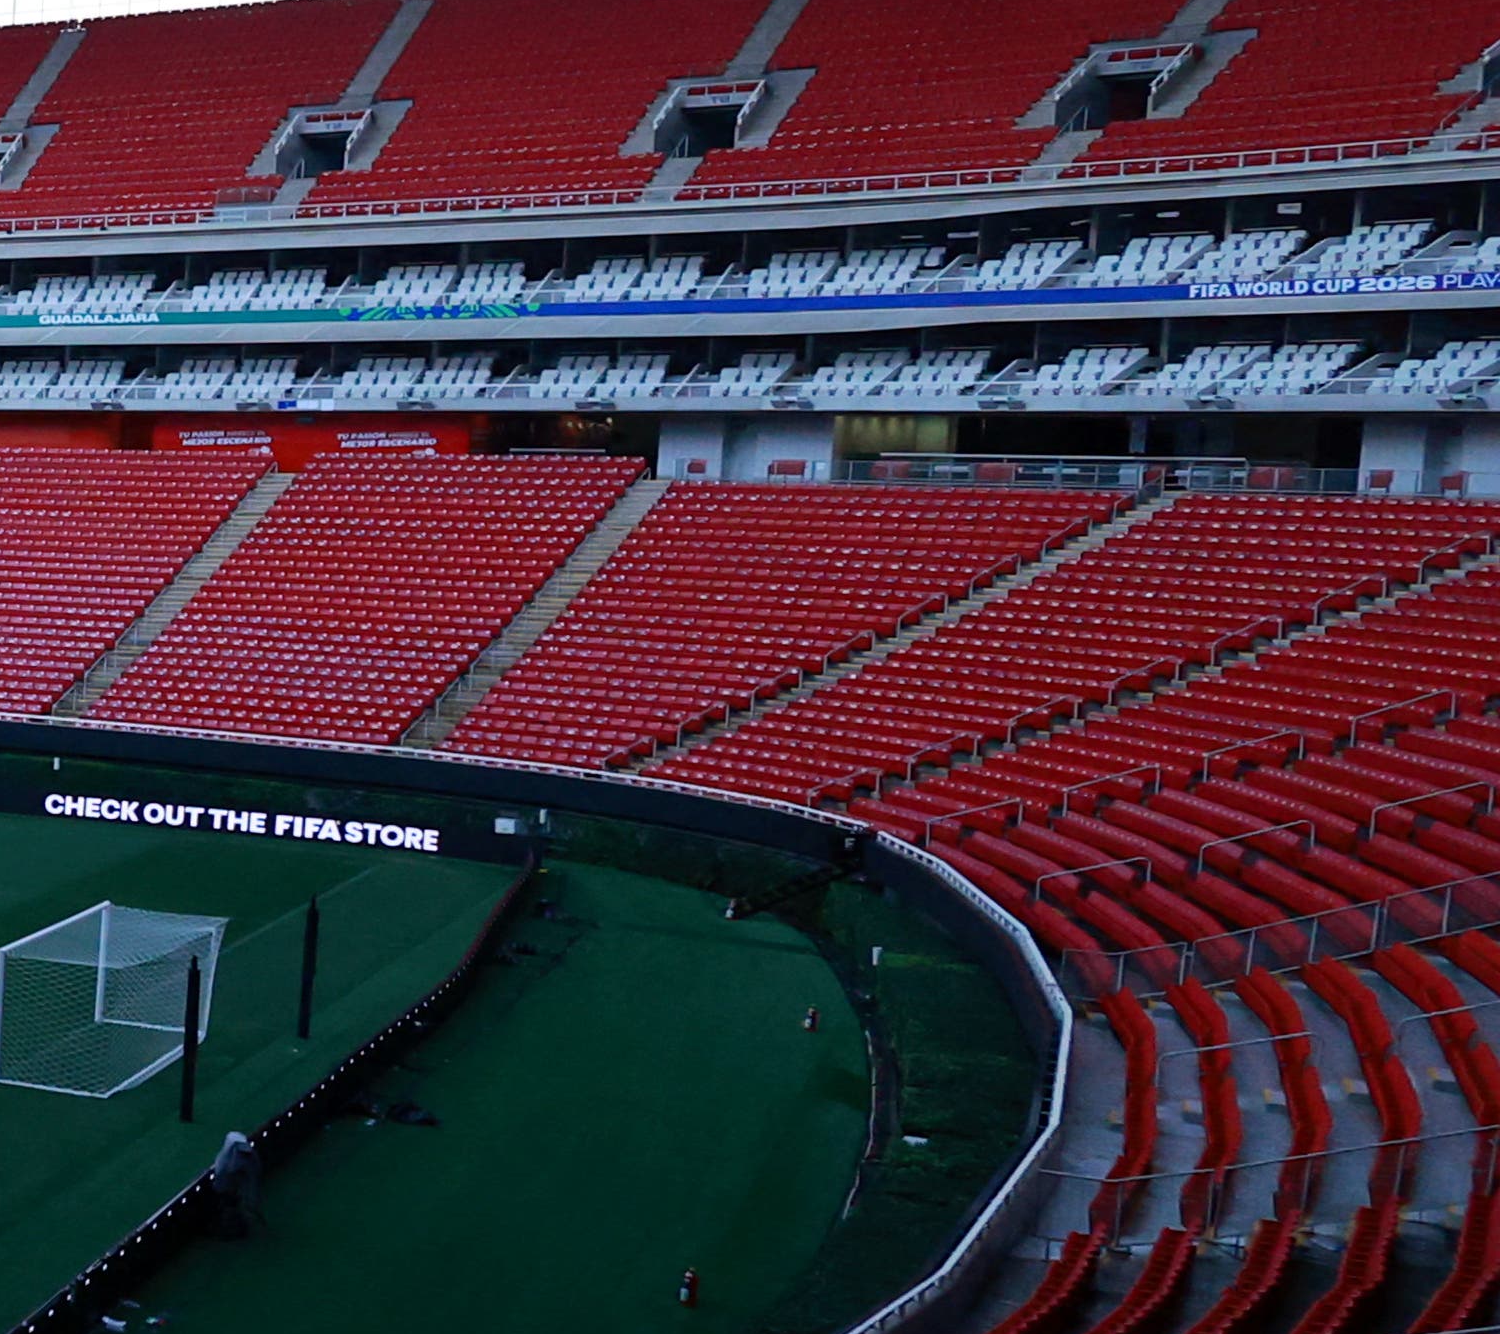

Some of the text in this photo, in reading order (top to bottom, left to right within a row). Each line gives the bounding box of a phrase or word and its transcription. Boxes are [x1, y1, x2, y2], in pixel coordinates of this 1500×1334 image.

[1190, 282, 1231, 298] FIFA
[1234, 281, 1309, 296] WORLD
[1313, 279, 1355, 294] CUP
[1359, 275, 1437, 291] 2026
[40, 313, 159, 325] GUADALAJARA
[45, 794, 439, 851] CHECK OUT THE FIFA STORE
